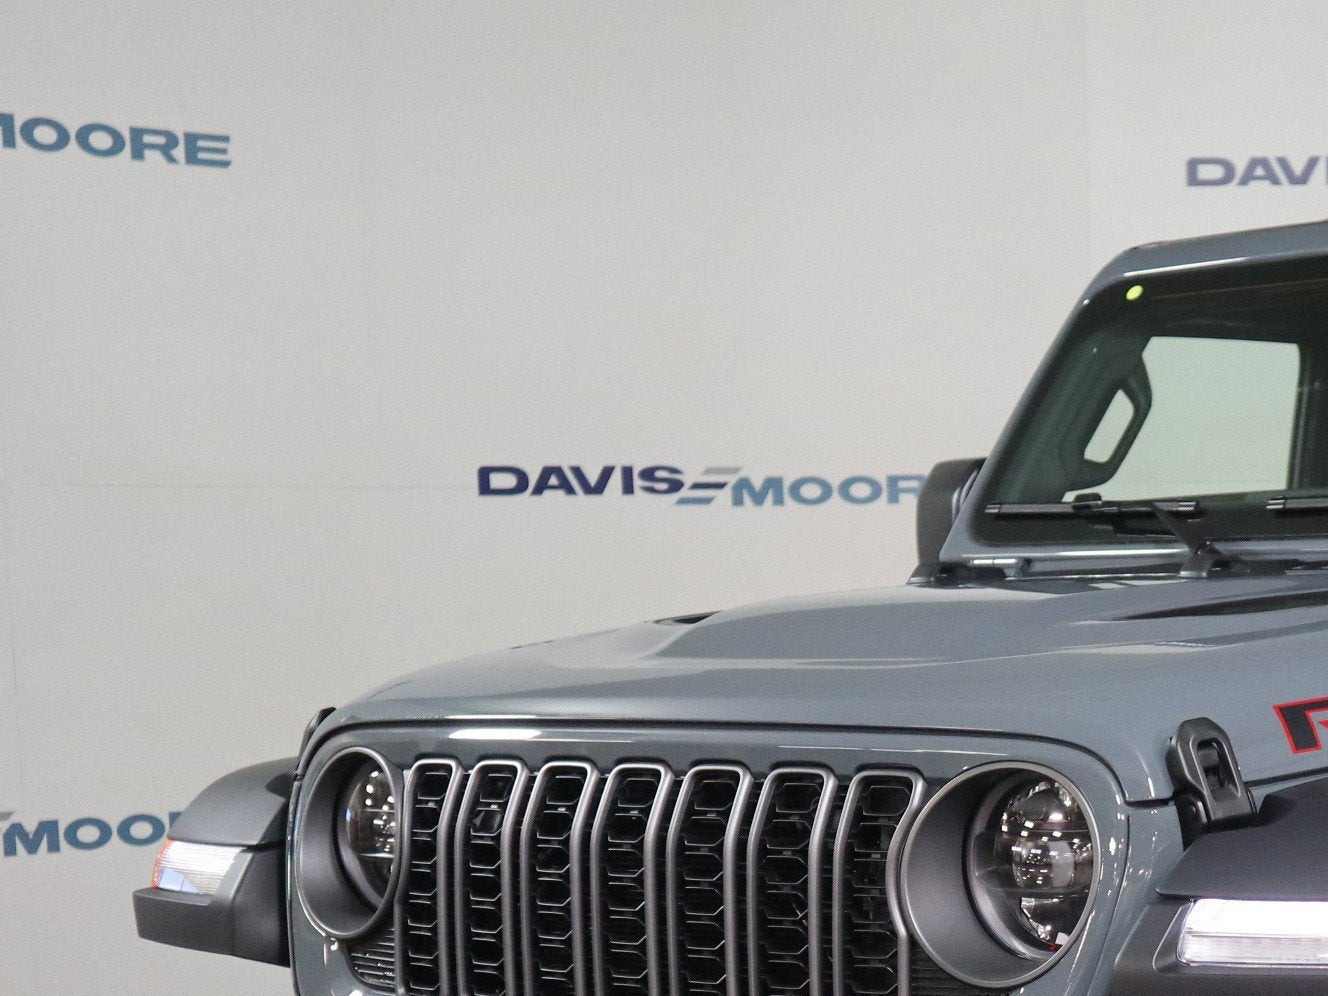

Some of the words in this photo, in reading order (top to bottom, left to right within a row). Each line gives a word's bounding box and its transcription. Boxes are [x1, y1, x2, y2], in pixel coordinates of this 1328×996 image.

[476, 465, 686, 497] DAVIS
[730, 474, 924, 507] MOOR
[3, 811, 182, 857] MOO
